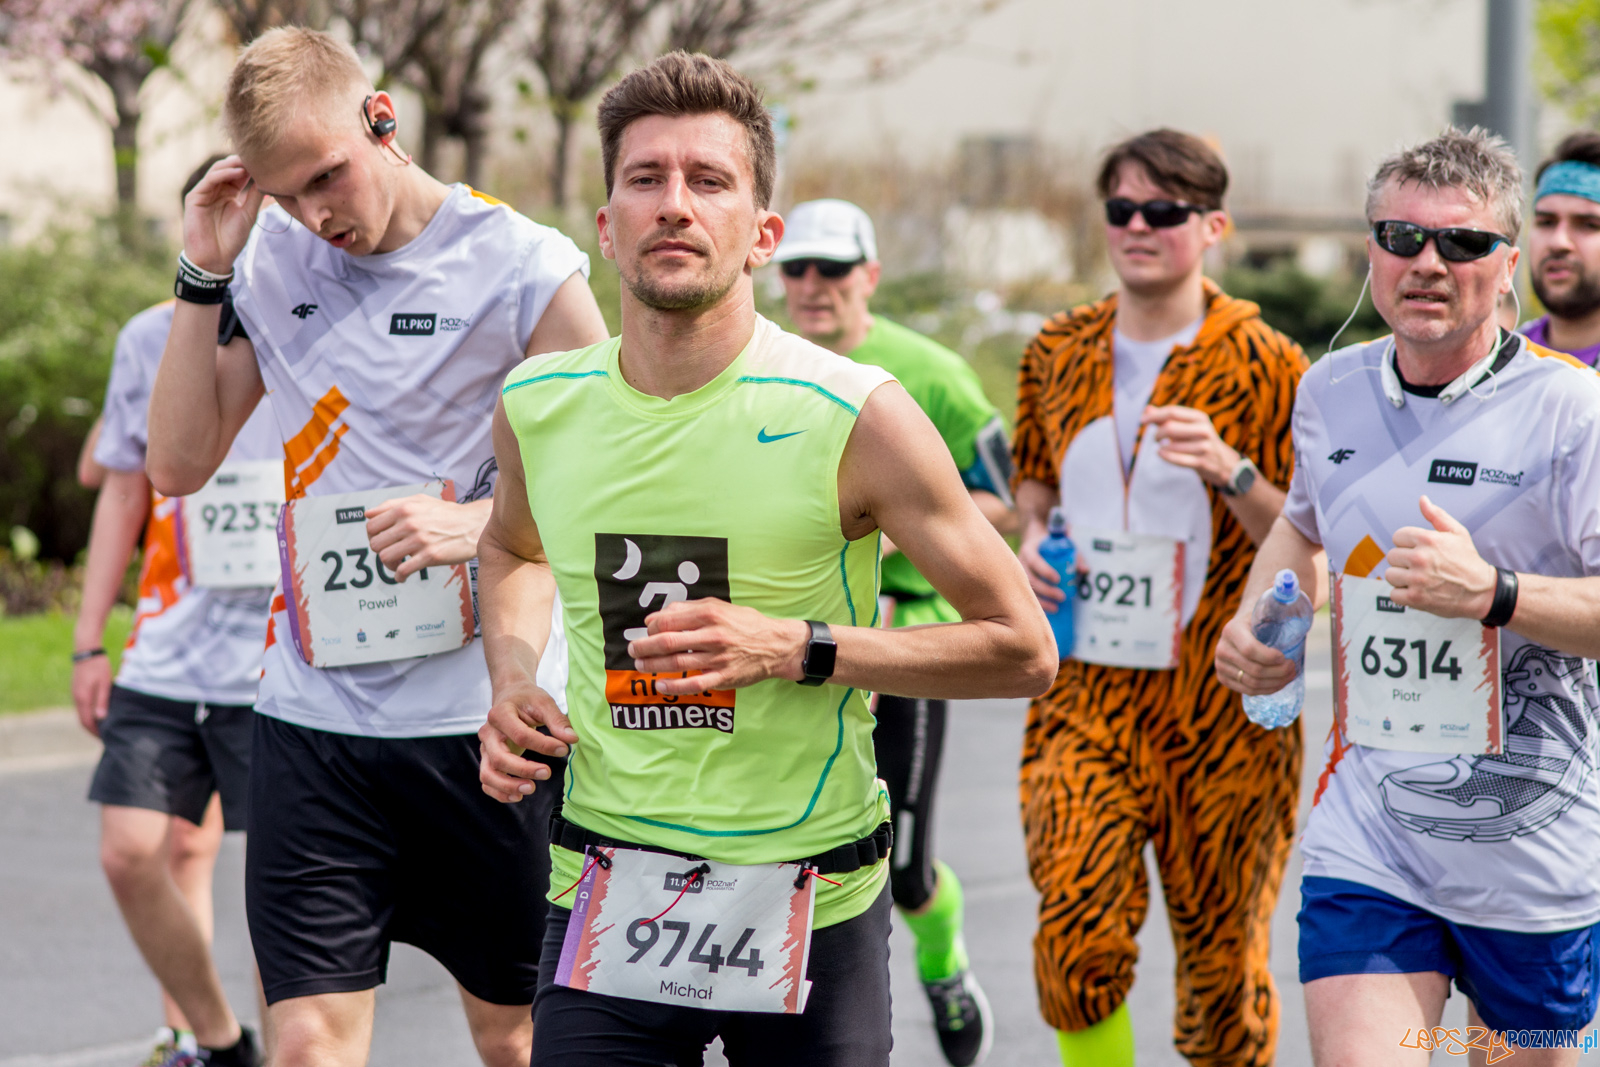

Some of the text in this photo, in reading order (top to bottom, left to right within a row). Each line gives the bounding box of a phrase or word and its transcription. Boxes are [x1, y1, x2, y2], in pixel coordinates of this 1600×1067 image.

[291, 303, 318, 319] 4F
[1327, 448, 1356, 465] 4F
[201, 503, 279, 532] 9233
[1077, 572, 1152, 608] 6921
[358, 595, 398, 611] Paweł
[1360, 635, 1462, 681] 6314
[1392, 689, 1422, 702] Piotr
[611, 705, 733, 731] runners
[580, 891, 589, 900] D
[626, 917, 764, 977] 9744
[659, 980, 713, 1000] Michał
